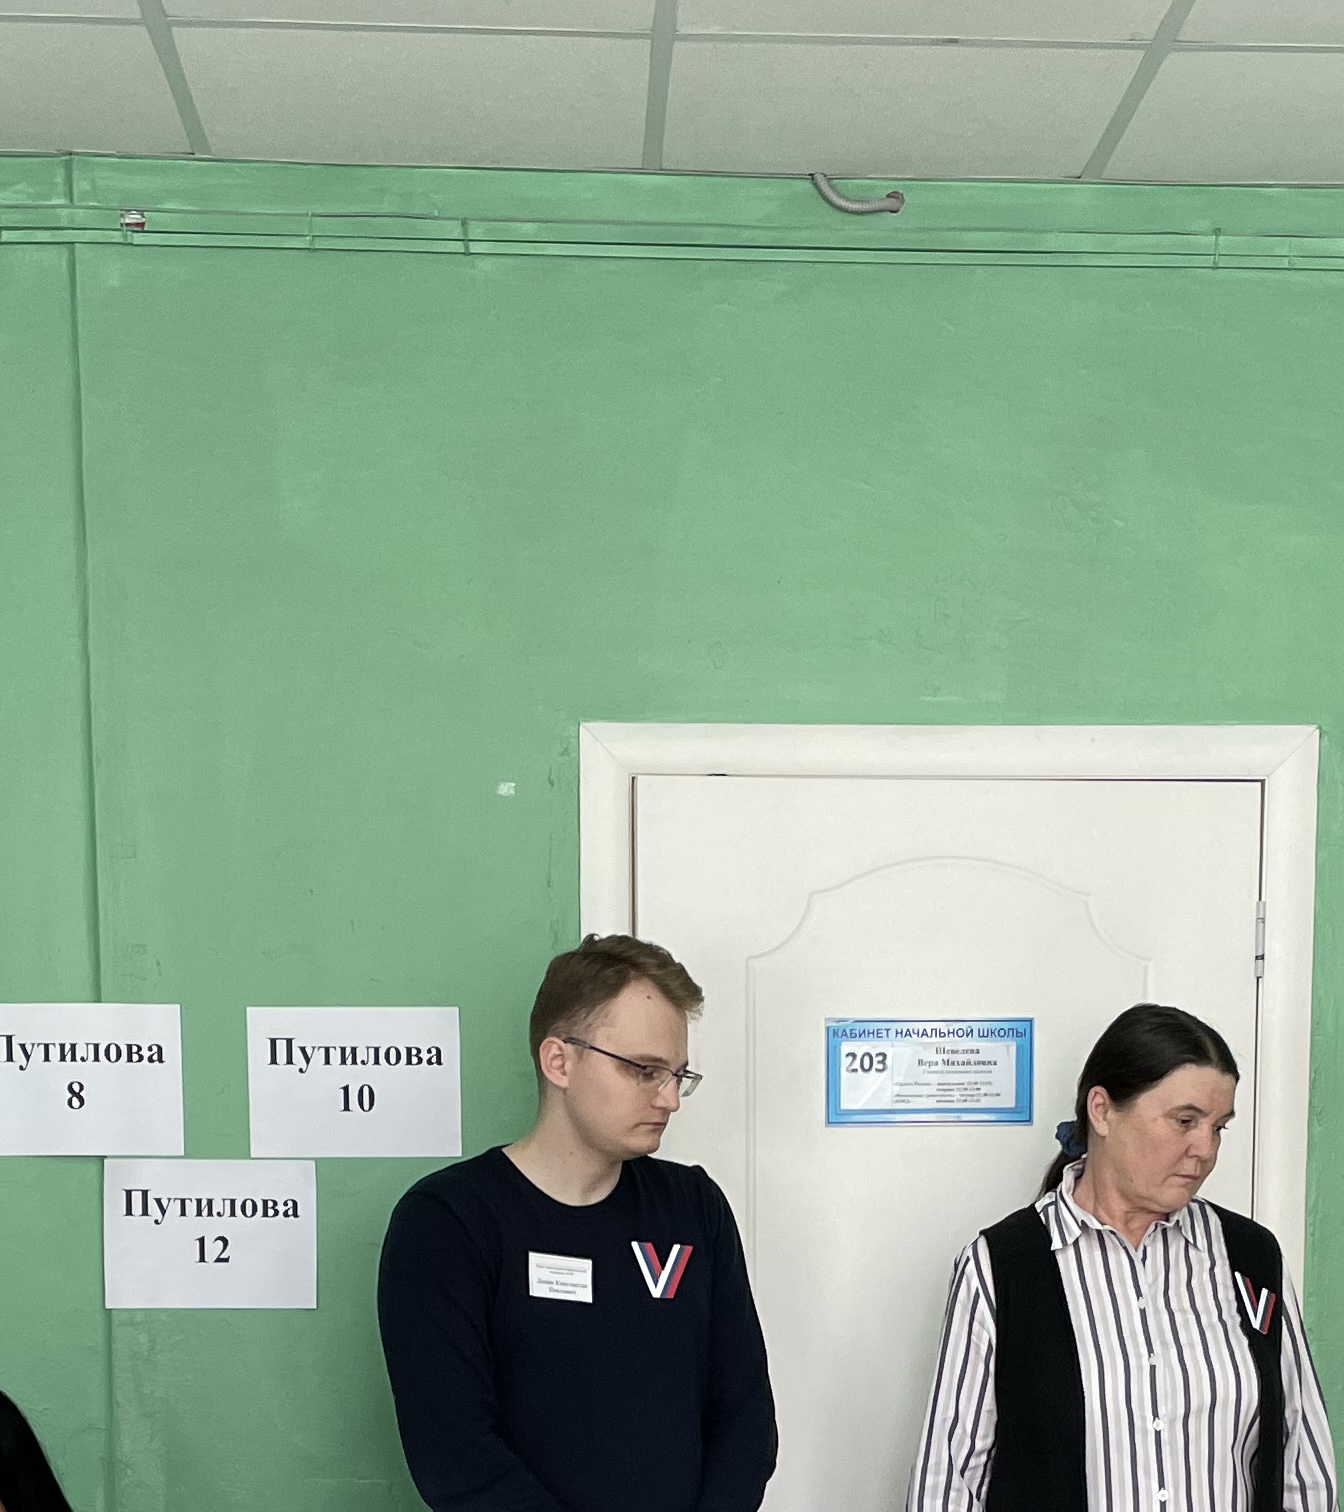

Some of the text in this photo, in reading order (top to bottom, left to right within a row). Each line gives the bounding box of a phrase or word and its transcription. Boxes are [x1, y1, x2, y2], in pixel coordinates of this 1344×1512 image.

[832, 1025, 1027, 1039] КАБИНЕТ НАЧАЛЬНОЙ ШКОЛЫ
[267, 1036, 444, 1074] Путилова
[844, 1051, 888, 1074] 203
[67, 1081, 86, 1111] 8
[340, 1083, 376, 1113] 10
[122, 1187, 301, 1227] Путилова
[195, 1235, 232, 1265] 12
